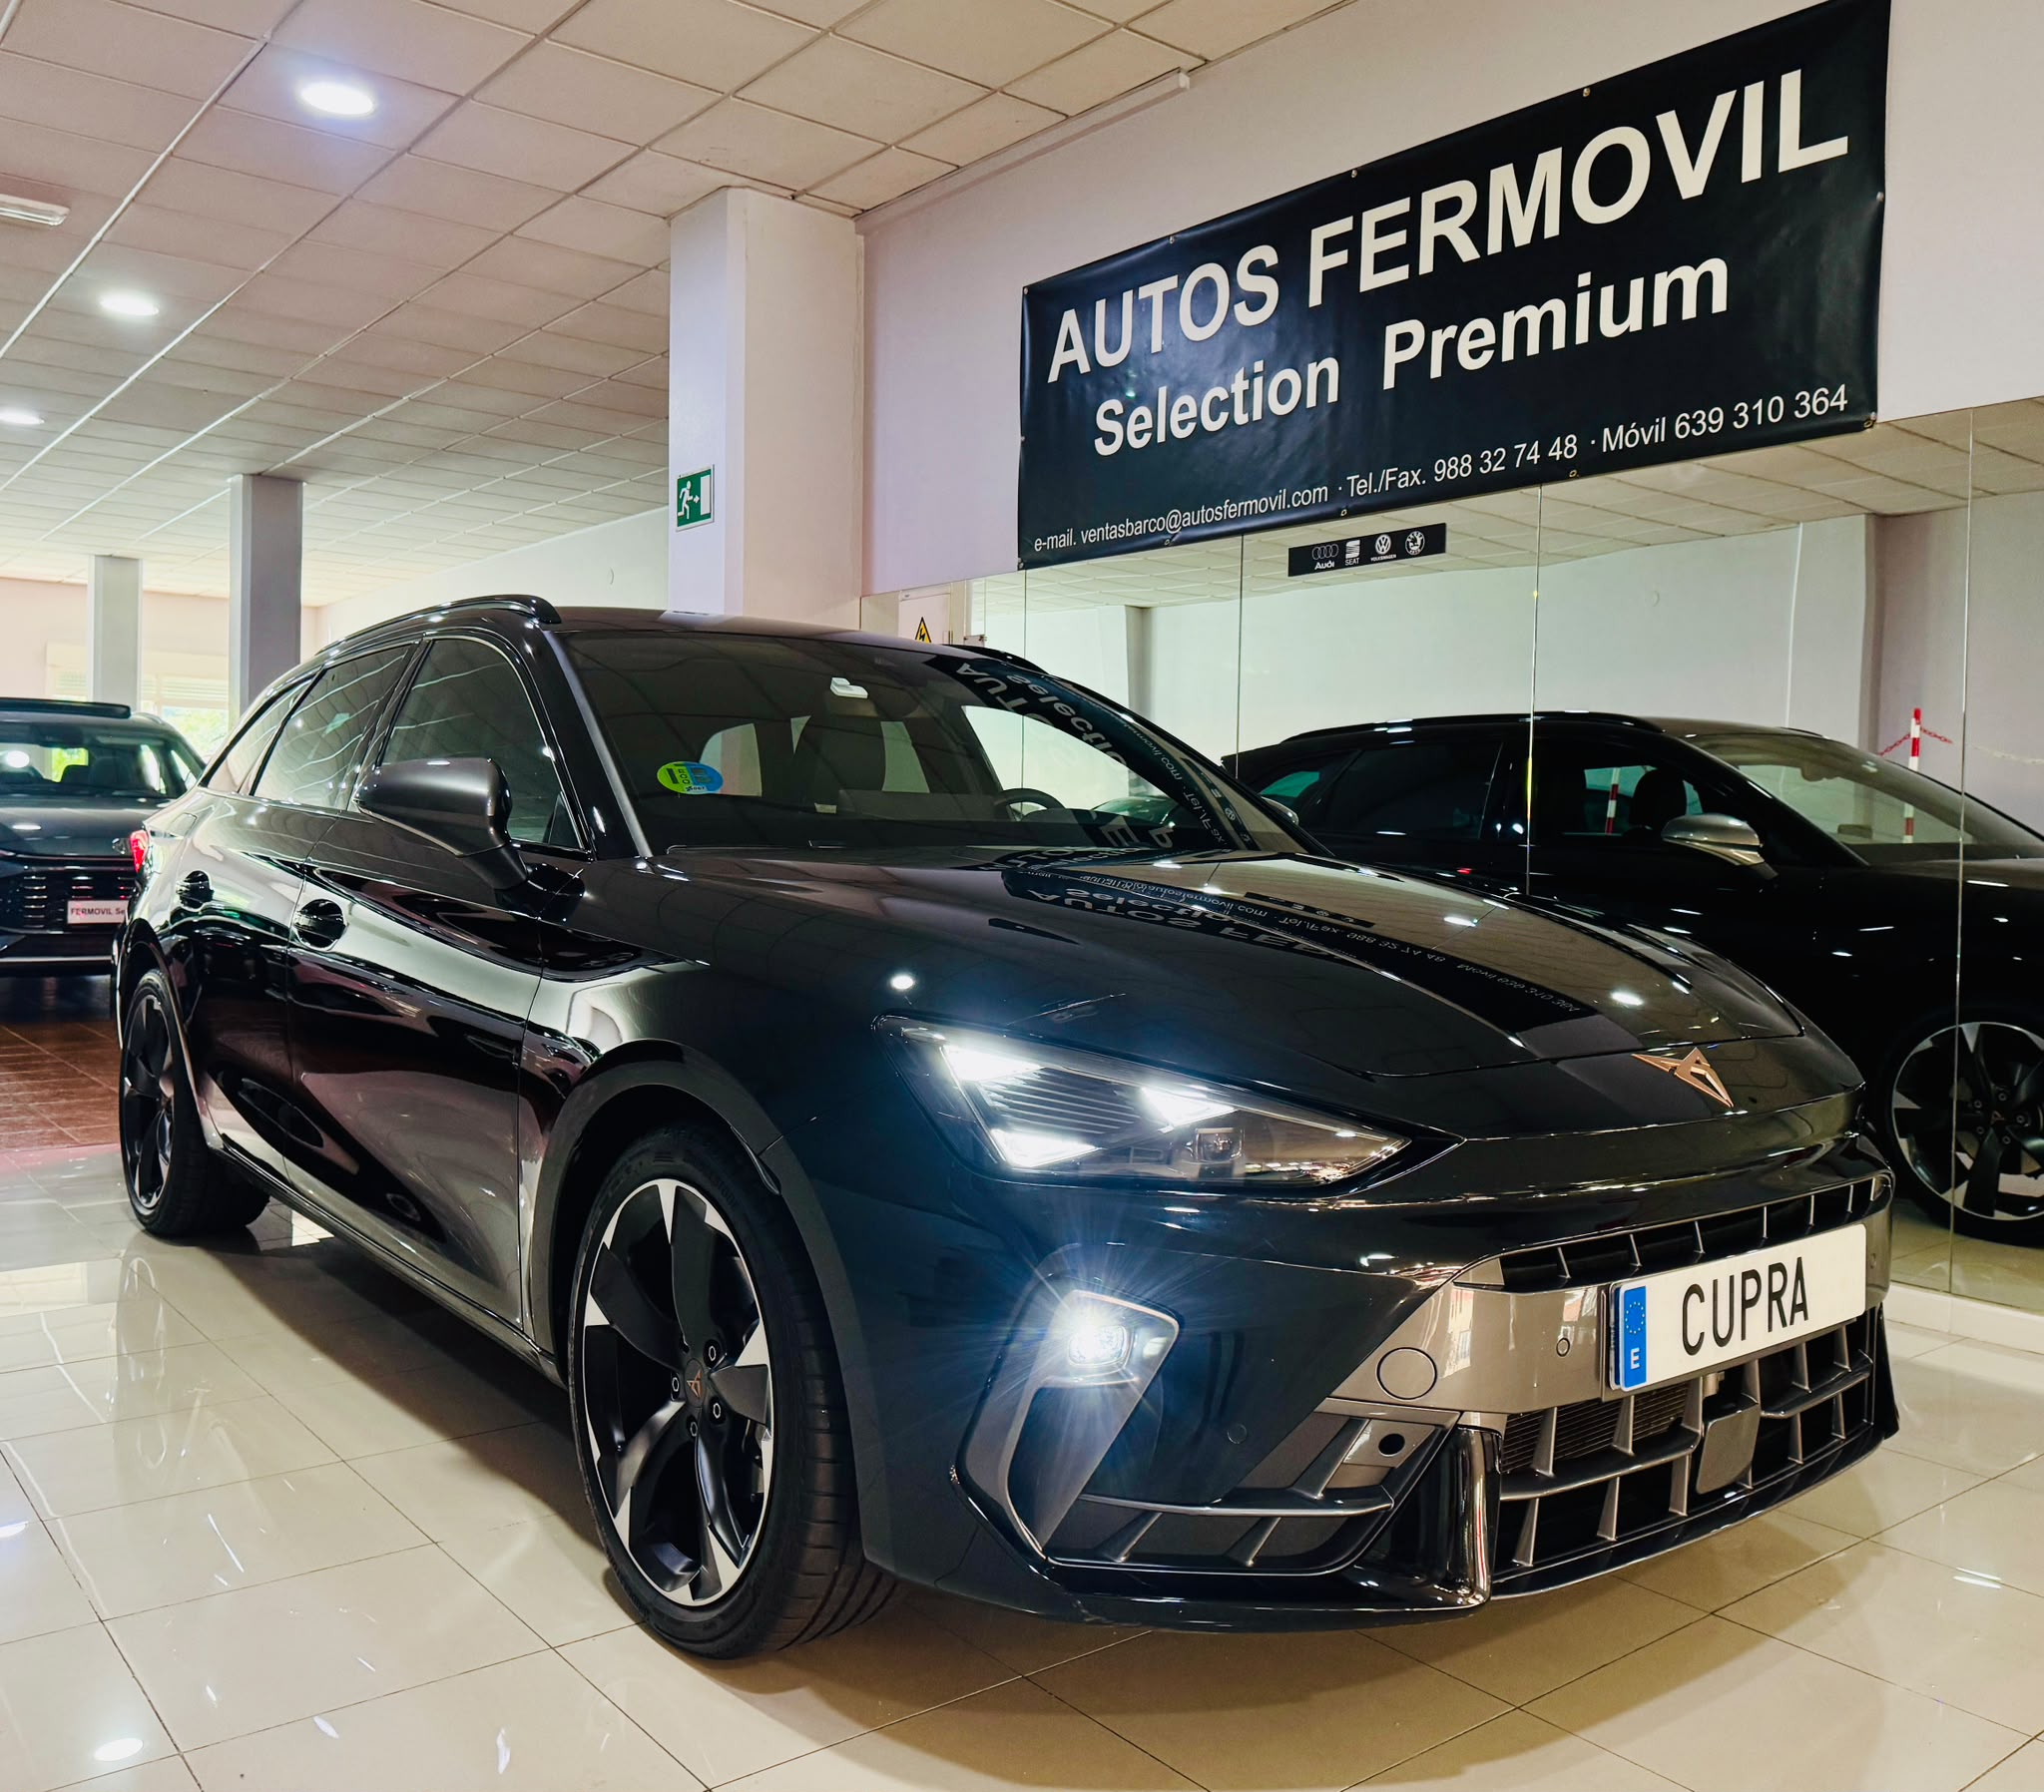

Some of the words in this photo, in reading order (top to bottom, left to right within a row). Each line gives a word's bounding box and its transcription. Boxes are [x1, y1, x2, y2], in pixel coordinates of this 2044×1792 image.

[1047, 244, 1278, 383] AUTOS
[1308, 69, 1848, 308] FERMOVIL
[1094, 356, 1339, 456] Selection
[1383, 257, 1728, 390] Premium
[1034, 528, 1077, 552] e-mail.
[1081, 485, 1328, 544] ventasbarco@autosfermovil.com
[1433, 454, 1472, 483] 988
[1479, 447, 1506, 475] 32
[1513, 440, 1540, 468] 74
[1548, 433, 1578, 461] 48
[1602, 416, 1666, 453] Móvil
[1674, 407, 1724, 440] 639
[1733, 395, 1785, 430] 310
[1793, 383, 1847, 419] 364
[1313, 561, 1335, 571] Audi
[1344, 557, 1359, 566] SEAT
[71, 907, 113, 916] FERMOVIL
[1682, 1256, 1808, 1356] CUPRA
[1630, 1347, 1640, 1370] E
